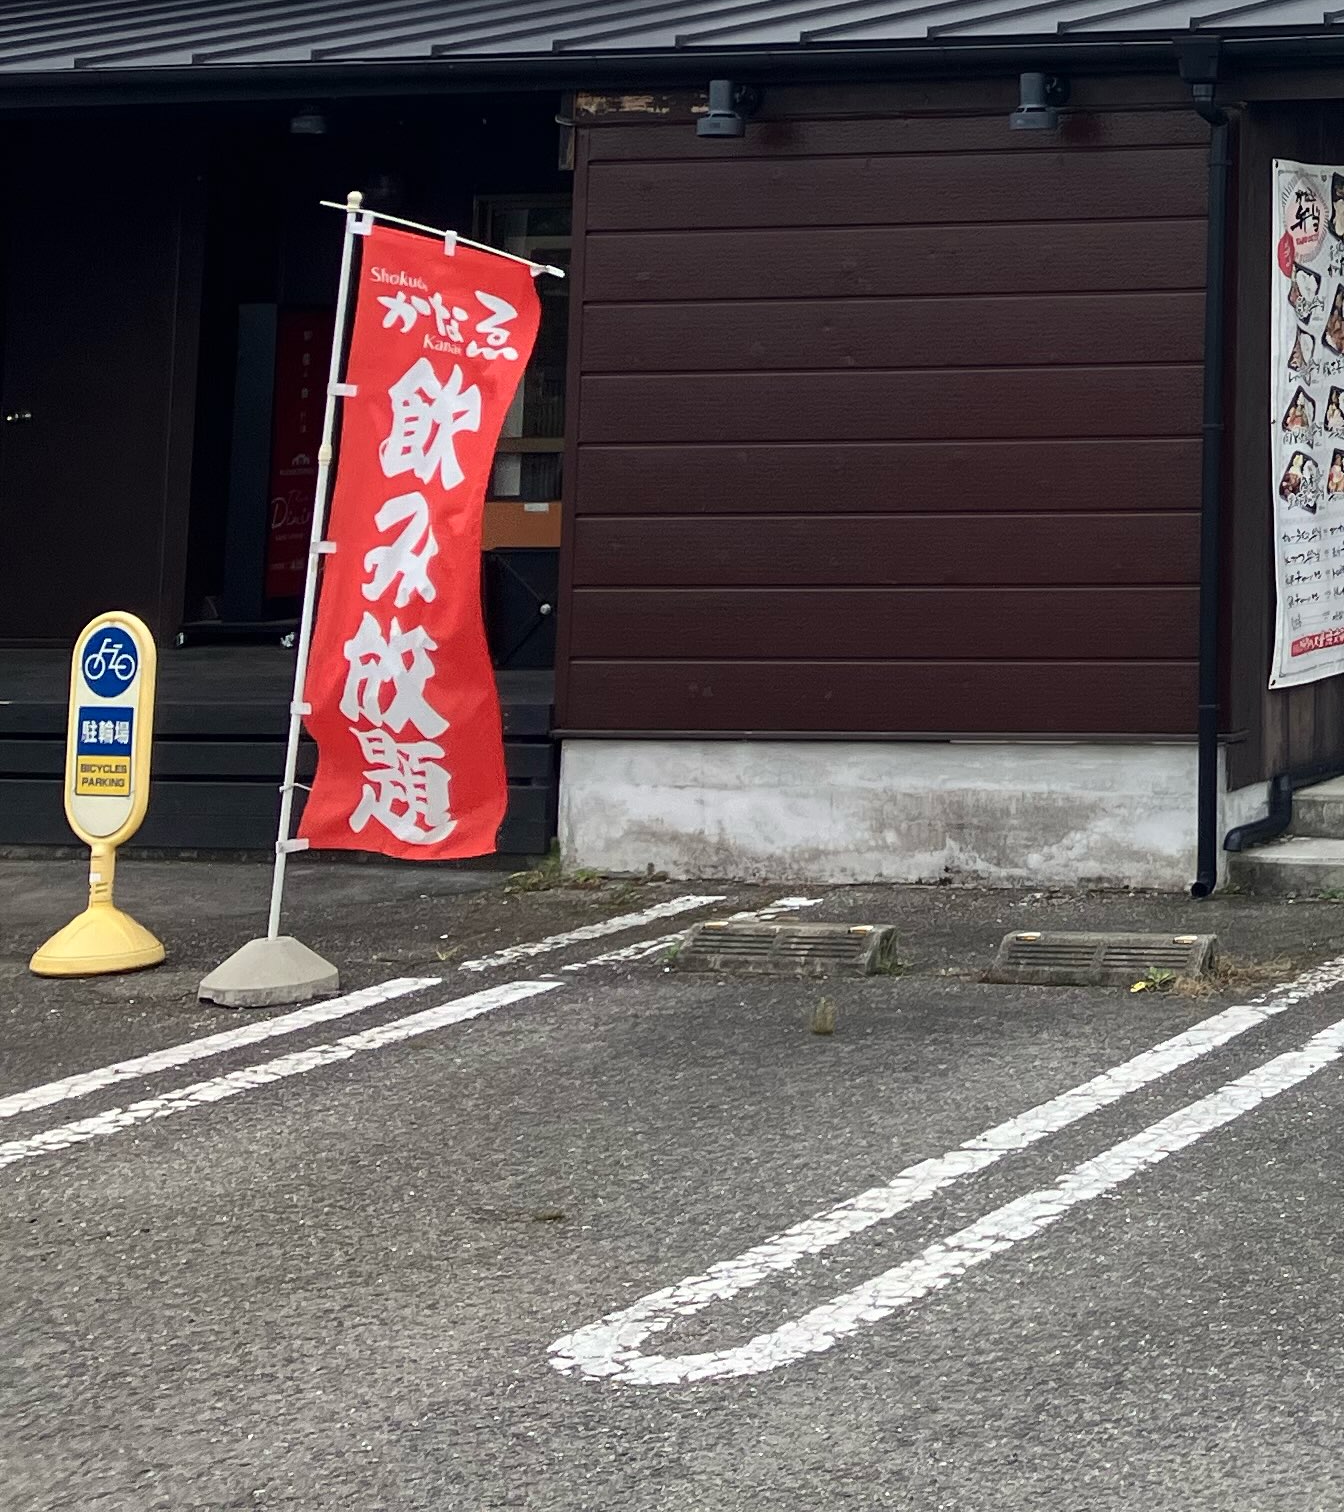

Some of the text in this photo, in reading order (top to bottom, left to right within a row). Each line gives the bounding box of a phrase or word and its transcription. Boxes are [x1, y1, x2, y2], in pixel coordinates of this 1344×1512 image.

[376, 290, 519, 361] かなゑ
[340, 357, 483, 844] 飲み放題
[80, 720, 130, 744] 駐輪場
[80, 763, 128, 774] BICYCLES
[81, 777, 125, 788] PARKING
